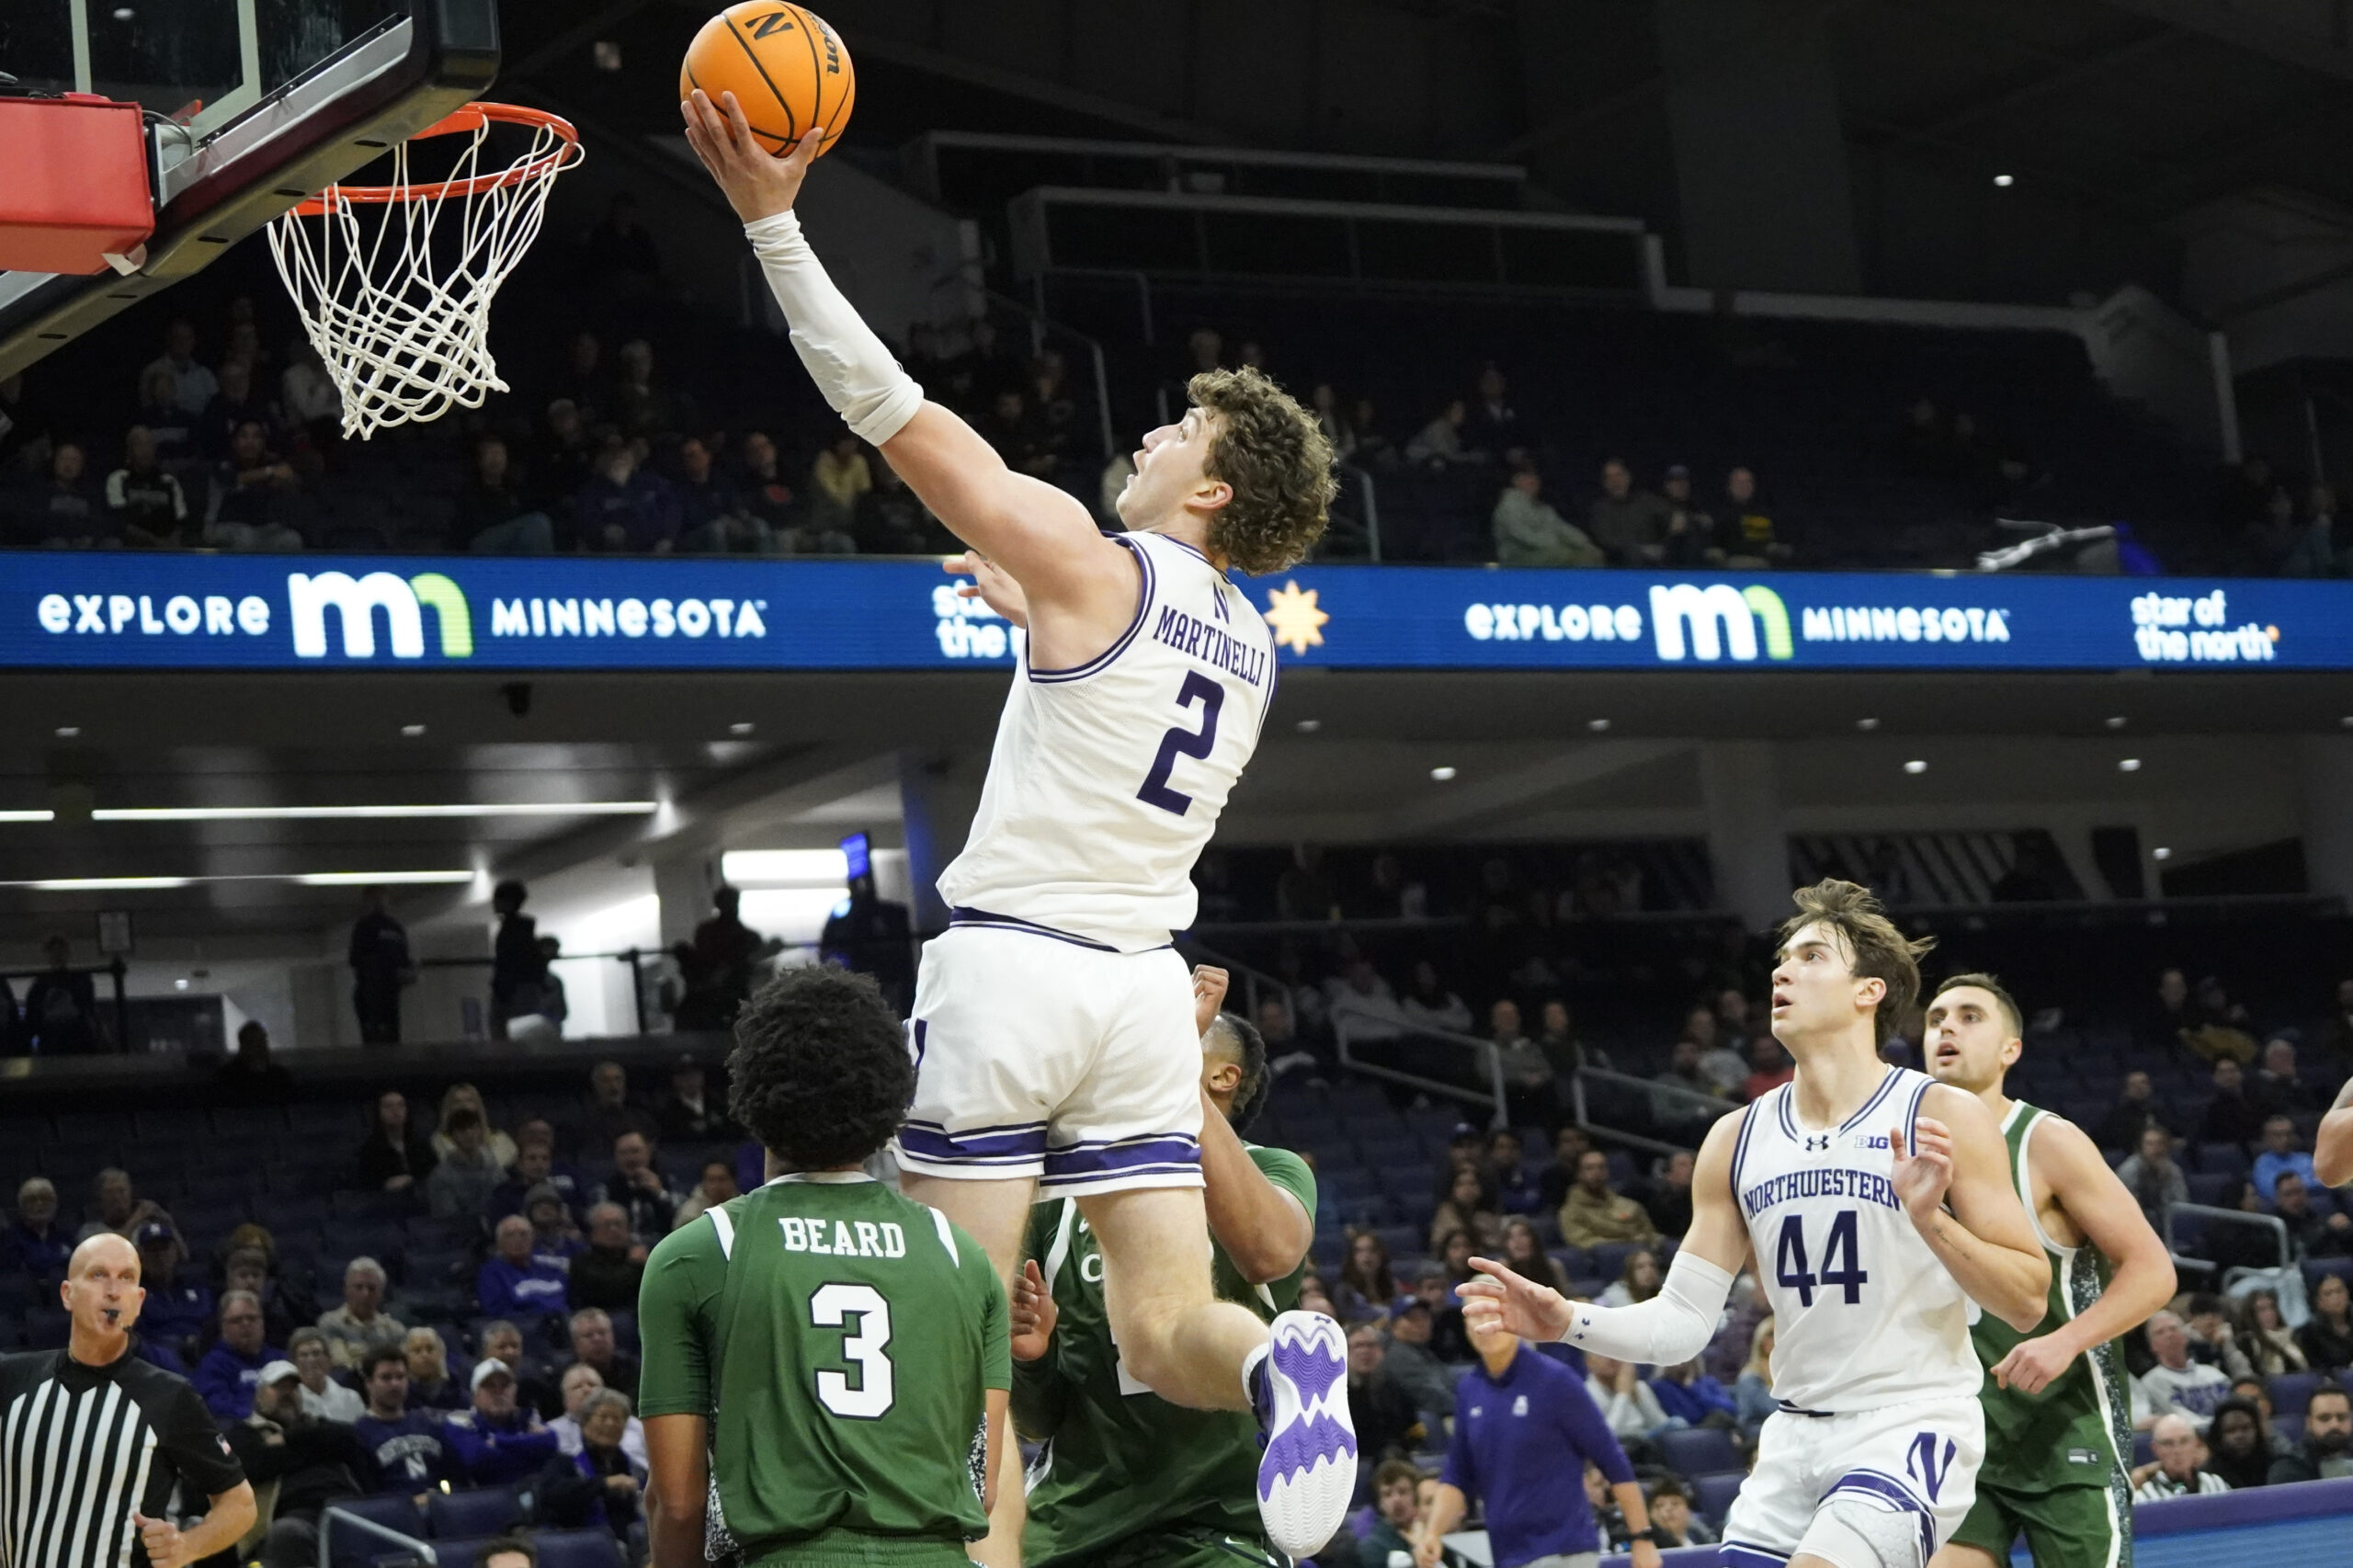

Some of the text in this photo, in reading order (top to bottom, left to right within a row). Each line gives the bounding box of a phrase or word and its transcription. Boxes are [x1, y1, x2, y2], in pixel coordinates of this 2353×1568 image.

[745, 12, 794, 40] N
[2130, 589, 2226, 627] star of
[936, 615, 1006, 658] the
[1153, 605, 1266, 687] MARTINELLI
[2134, 622, 2275, 661] the north
[1136, 669, 1224, 816] 2
[1744, 1168, 1901, 1221] NORTHWESTERN
[779, 1217, 906, 1258] BEARD
[1776, 1210, 1868, 1308] 44
[808, 1280, 896, 1422] 3
